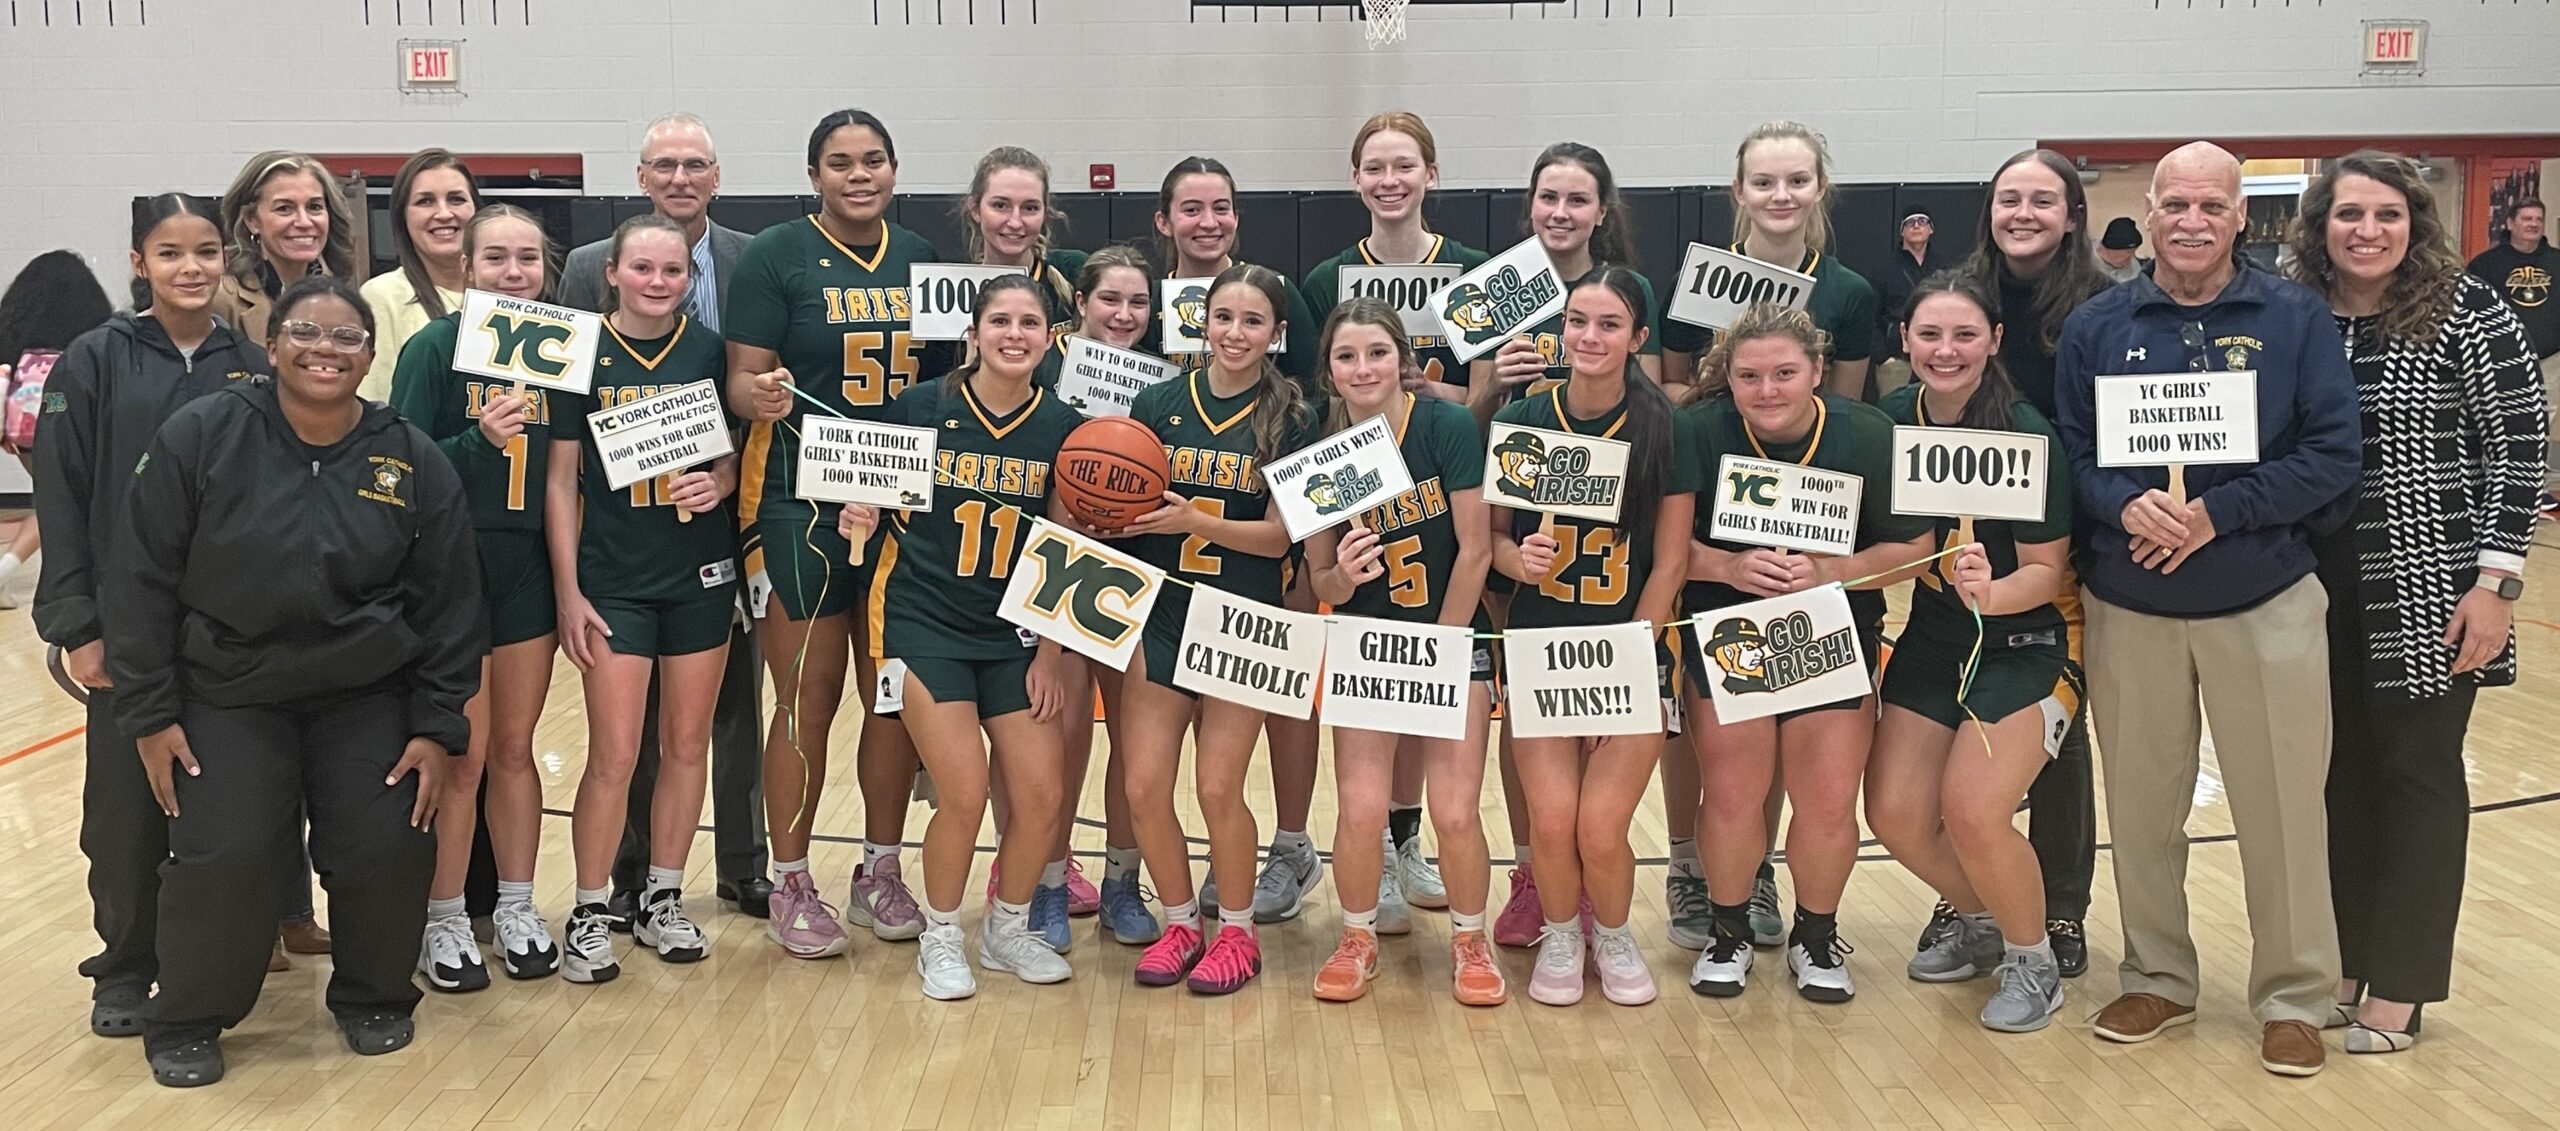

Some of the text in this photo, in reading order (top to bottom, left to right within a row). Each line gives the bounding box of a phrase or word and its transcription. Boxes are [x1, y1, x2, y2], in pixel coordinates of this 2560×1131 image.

[2377, 32, 2413, 57] EXIT
[414, 52, 448, 77] EXIT
[918, 277, 993, 314] 100
[1485, 264, 1521, 303] GO
[1490, 268, 1559, 333] IRISH!
[496, 299, 575, 322] YORK CATHOLIC
[823, 287, 911, 323] IRIS
[483, 311, 575, 379] YC
[1085, 346, 1105, 361] WAY
[1109, 352, 1120, 365] TO
[1123, 358, 1136, 370] GO
[1138, 361, 1164, 378] IRISH
[842, 331, 926, 406] 55
[1076, 363, 1151, 390] GIRLS BASKETB
[1087, 386, 1111, 401] 1000
[2139, 382, 2211, 400] YC GIRLS'
[595, 417, 616, 433] YC
[617, 406, 652, 426] YORK
[653, 387, 712, 414] CATHOLIC
[661, 402, 716, 427] ATHLETICS
[2129, 406, 2224, 424] BASKETBALL
[608, 446, 633, 462] 1000
[635, 437, 661, 453] WINS
[664, 430, 684, 446] FOR
[818, 426, 919, 451] YORK CATHOLIC
[1314, 441, 1350, 466] GIRLS
[1350, 425, 1385, 449] WIN!!
[2127, 432, 2227, 453] 1000 WINS!
[503, 434, 528, 510] 1
[638, 443, 699, 471] BASKETBALL
[804, 445, 930, 472] GIRLS' BASKETBALL
[935, 449, 1050, 498] IRISH
[1163, 445, 1259, 493] RISH
[1548, 446, 1590, 475] GO
[1733, 462, 1781, 474] YORK CATHOLIC
[1906, 443, 2032, 489] 1000!!
[821, 467, 898, 489] 1000 WINS!!
[1070, 459, 1150, 495] THE ROCK
[1333, 463, 1359, 488] GO
[1337, 468, 1383, 510] IRISH!
[1534, 476, 1619, 506] IRISH!
[1726, 470, 1782, 509] YC
[1791, 497, 1849, 520] WIN FOR
[954, 500, 1022, 579] 11
[1718, 512, 1850, 545] GIRLS BASKETBALL!
[1383, 534, 1429, 608] 5
[1539, 524, 1631, 605] 23
[1027, 532, 1149, 645] YC
[1220, 604, 1293, 651] YORK
[1765, 610, 1812, 654] GO
[1360, 631, 1438, 668] GIRLS
[1544, 639, 1614, 671] 1000
[1764, 626, 1856, 691] IRISH!
[1185, 641, 1310, 699] CATHOLIC
[1331, 672, 1459, 708] BASKETBALL
[1533, 685, 1632, 718] WINS!!!
